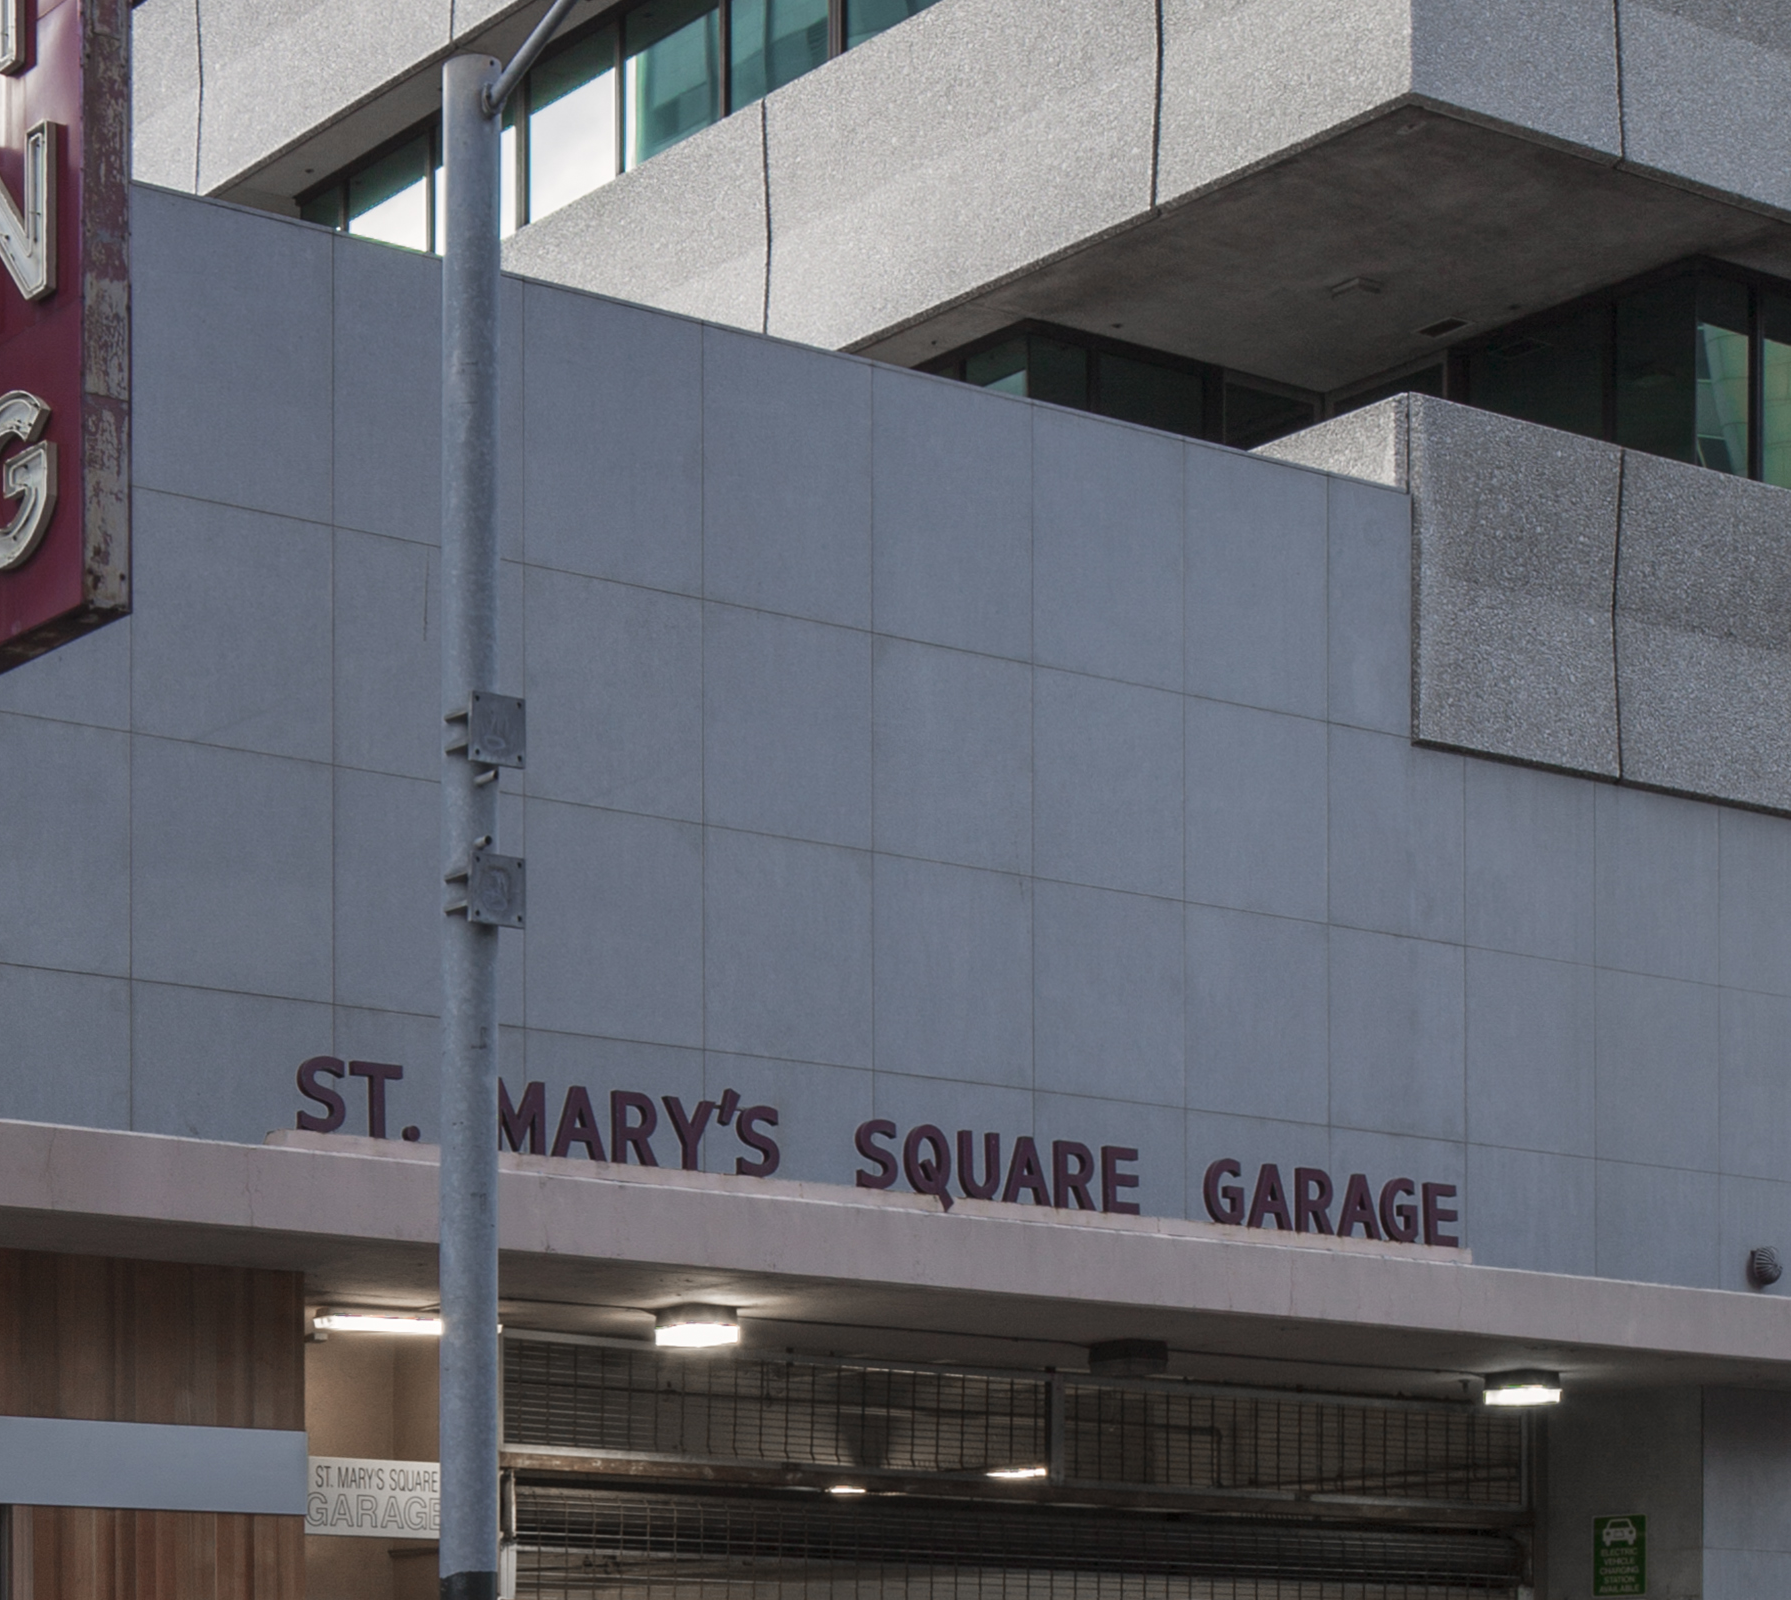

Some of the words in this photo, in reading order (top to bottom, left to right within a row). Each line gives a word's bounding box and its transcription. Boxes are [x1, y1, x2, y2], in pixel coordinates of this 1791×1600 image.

[295, 1055, 421, 1142] ST.
[498, 1077, 781, 1178] MARY'S
[854, 1118, 1141, 1213] SQUARE
[1202, 1158, 1460, 1248] GARAGE
[315, 1465, 334, 1488] ST.
[337, 1466, 385, 1491] MARY'S
[389, 1468, 439, 1493] SQUARE
[305, 1491, 441, 1531] GARAGE
